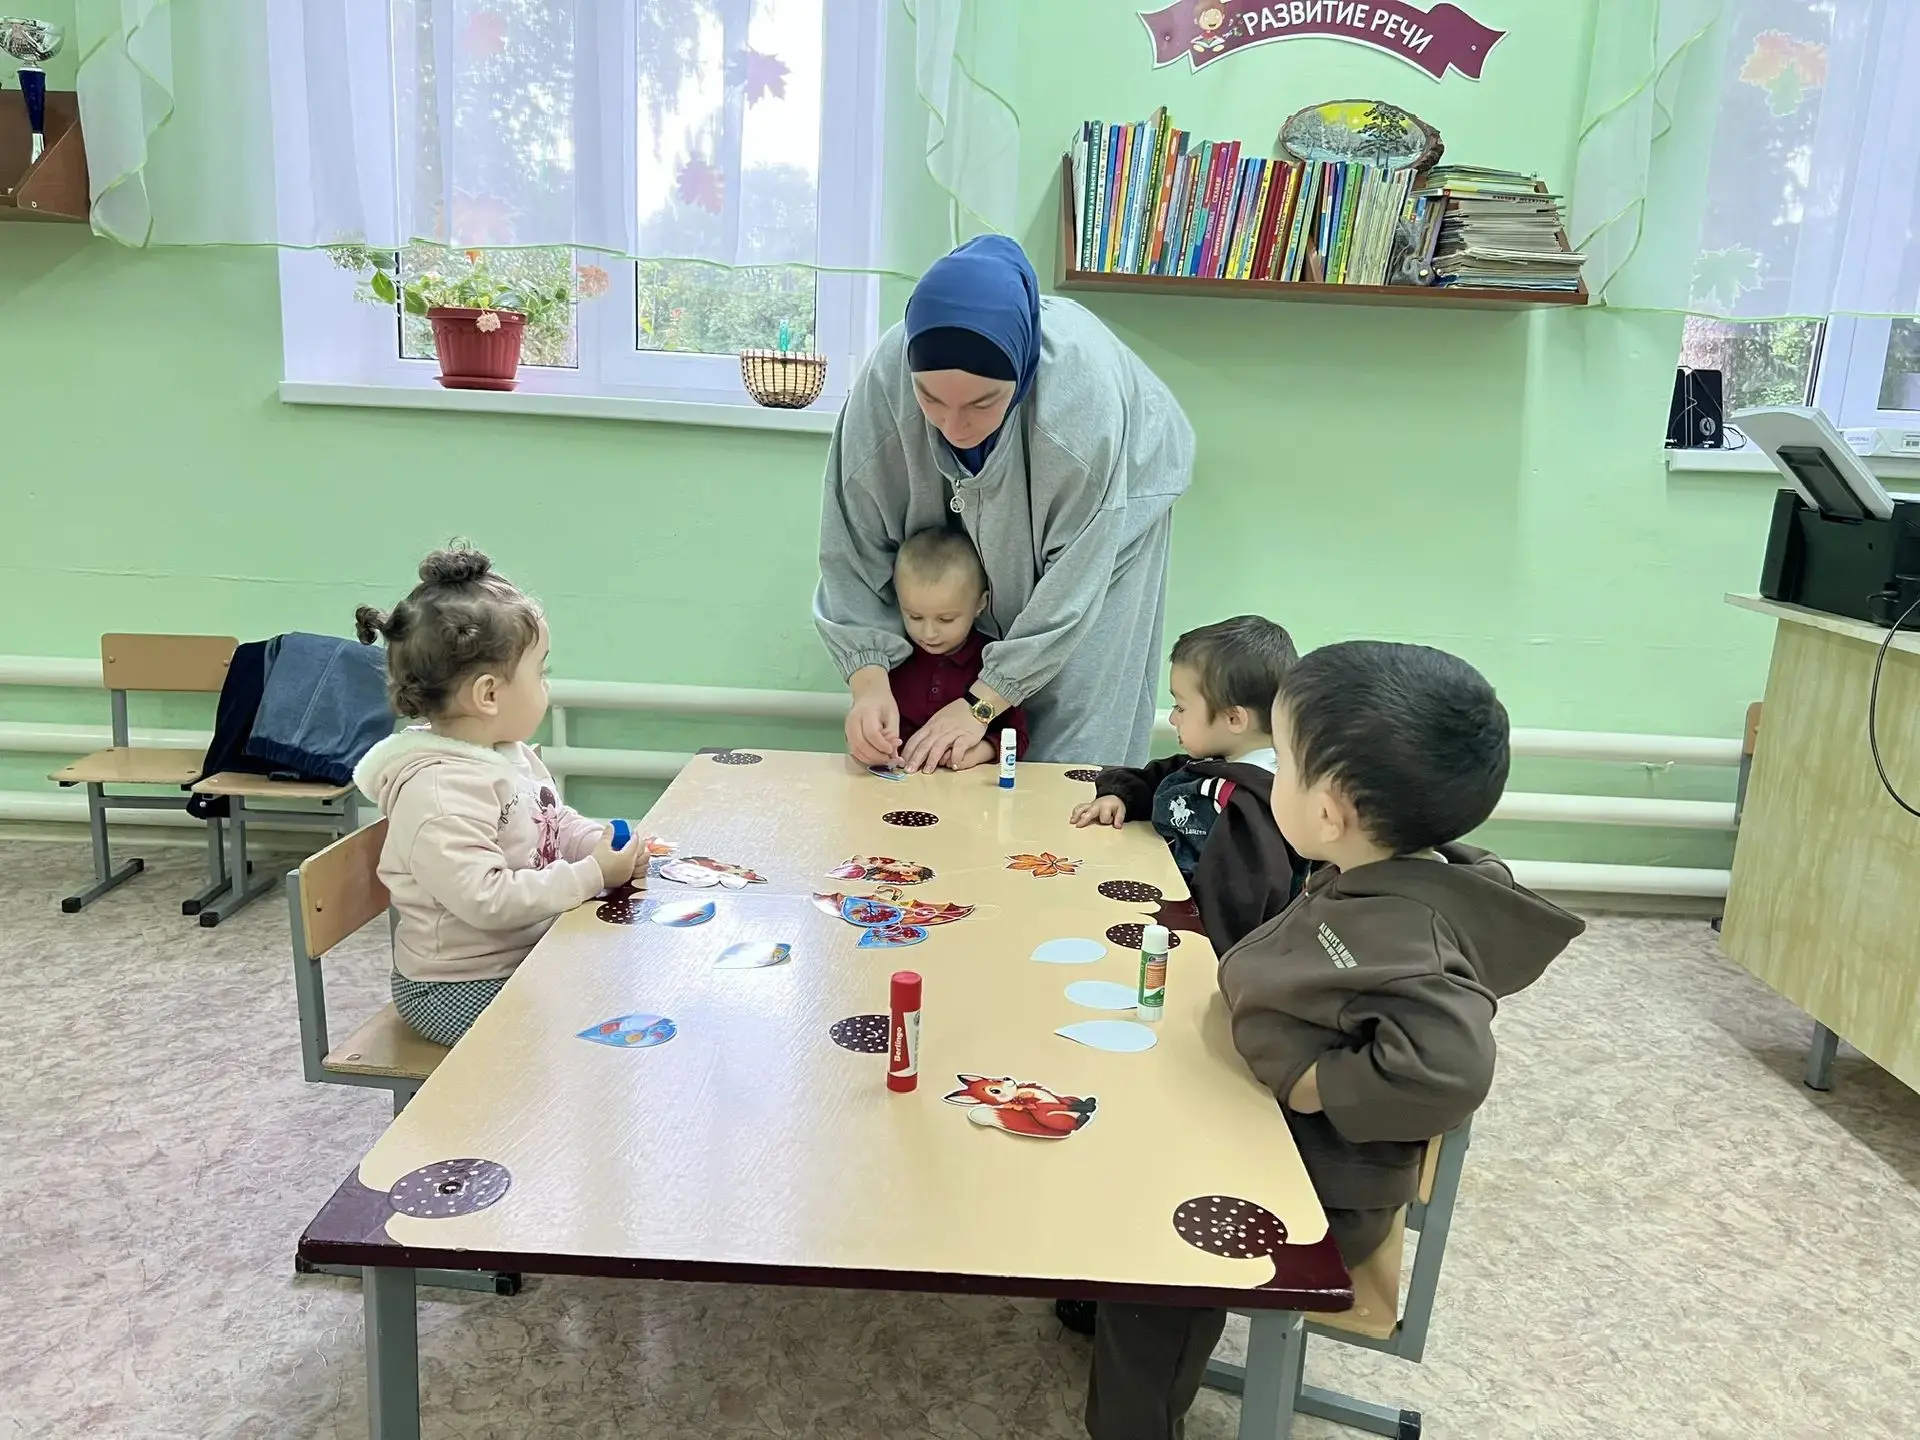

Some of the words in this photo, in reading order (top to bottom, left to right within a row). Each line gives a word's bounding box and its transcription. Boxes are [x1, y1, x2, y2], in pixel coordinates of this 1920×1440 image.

[1243, 0, 1369, 36] РАЗВИТИЕ
[1370, 9, 1433, 54] РЕЧИ
[1319, 922, 1340, 947] ALWAYS
[894, 1027, 903, 1062] Berlingo
